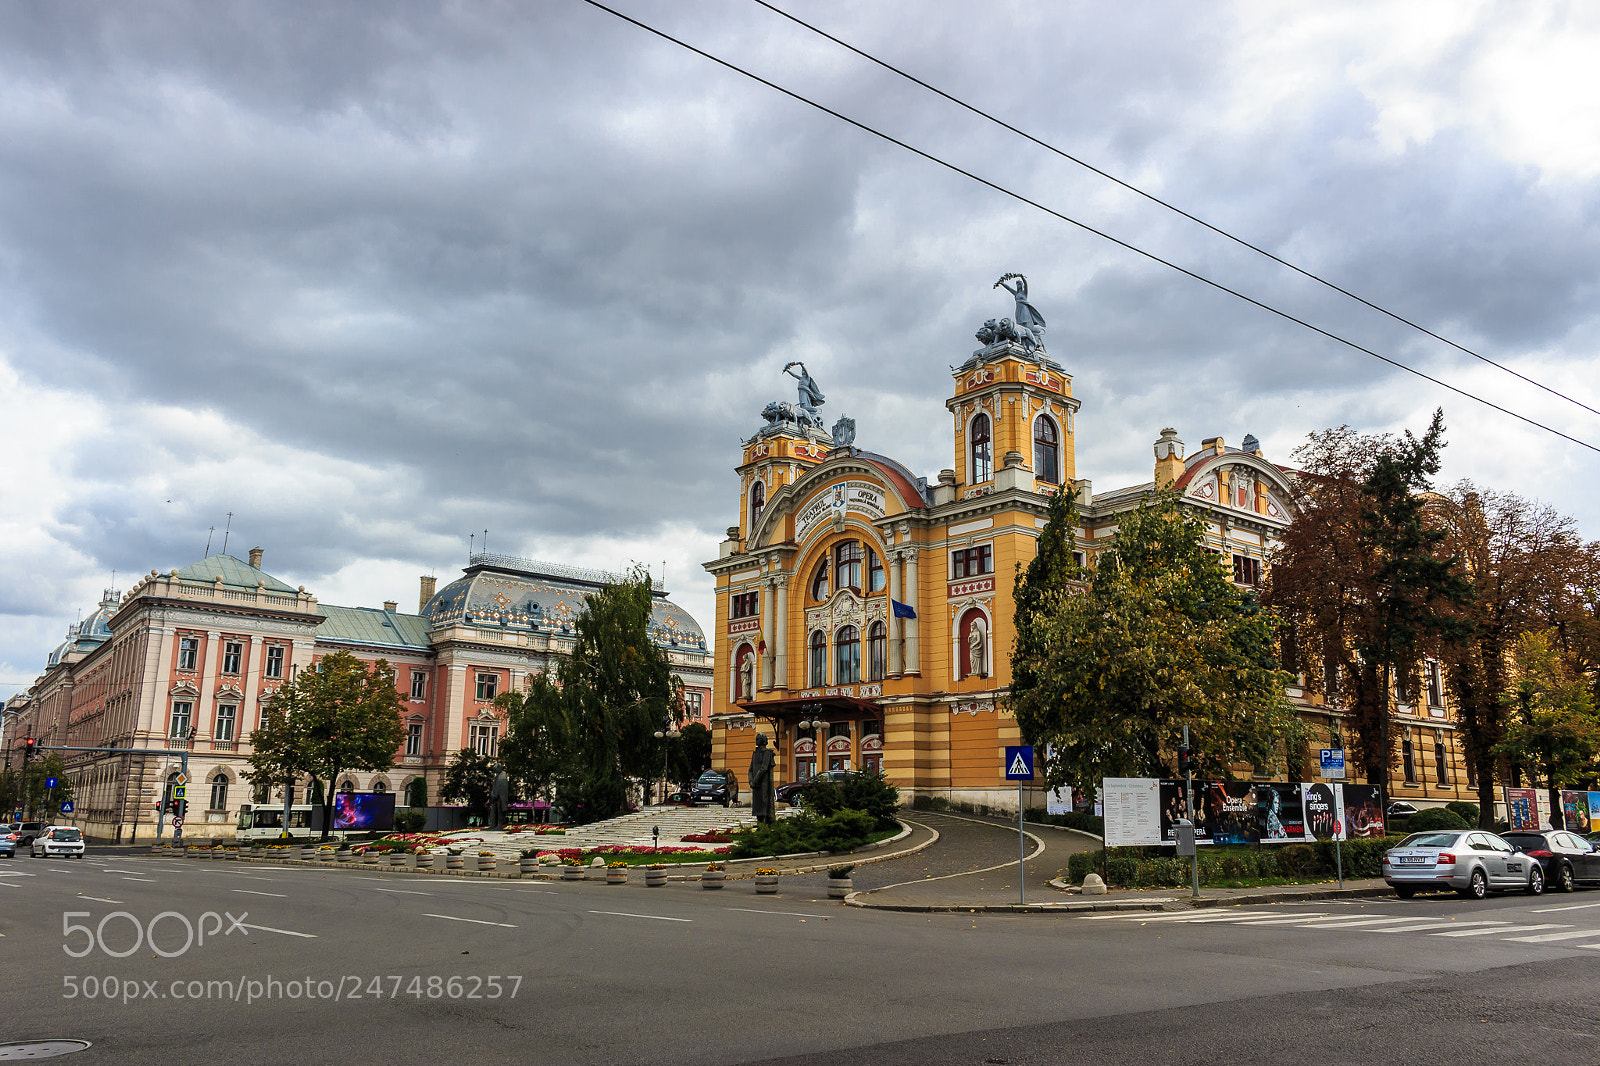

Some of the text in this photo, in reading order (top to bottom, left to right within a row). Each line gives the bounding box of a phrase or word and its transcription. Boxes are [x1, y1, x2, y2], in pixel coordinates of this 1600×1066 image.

[857, 490, 878, 503] OPERA
[1322, 750, 1330, 762] P
[1226, 796, 1243, 804] Opera
[1305, 792, 1322, 802] king's
[1222, 804, 1247, 812] Ensemble
[1310, 801, 1328, 812] singers
[1194, 826, 1207, 835] PERĂ
